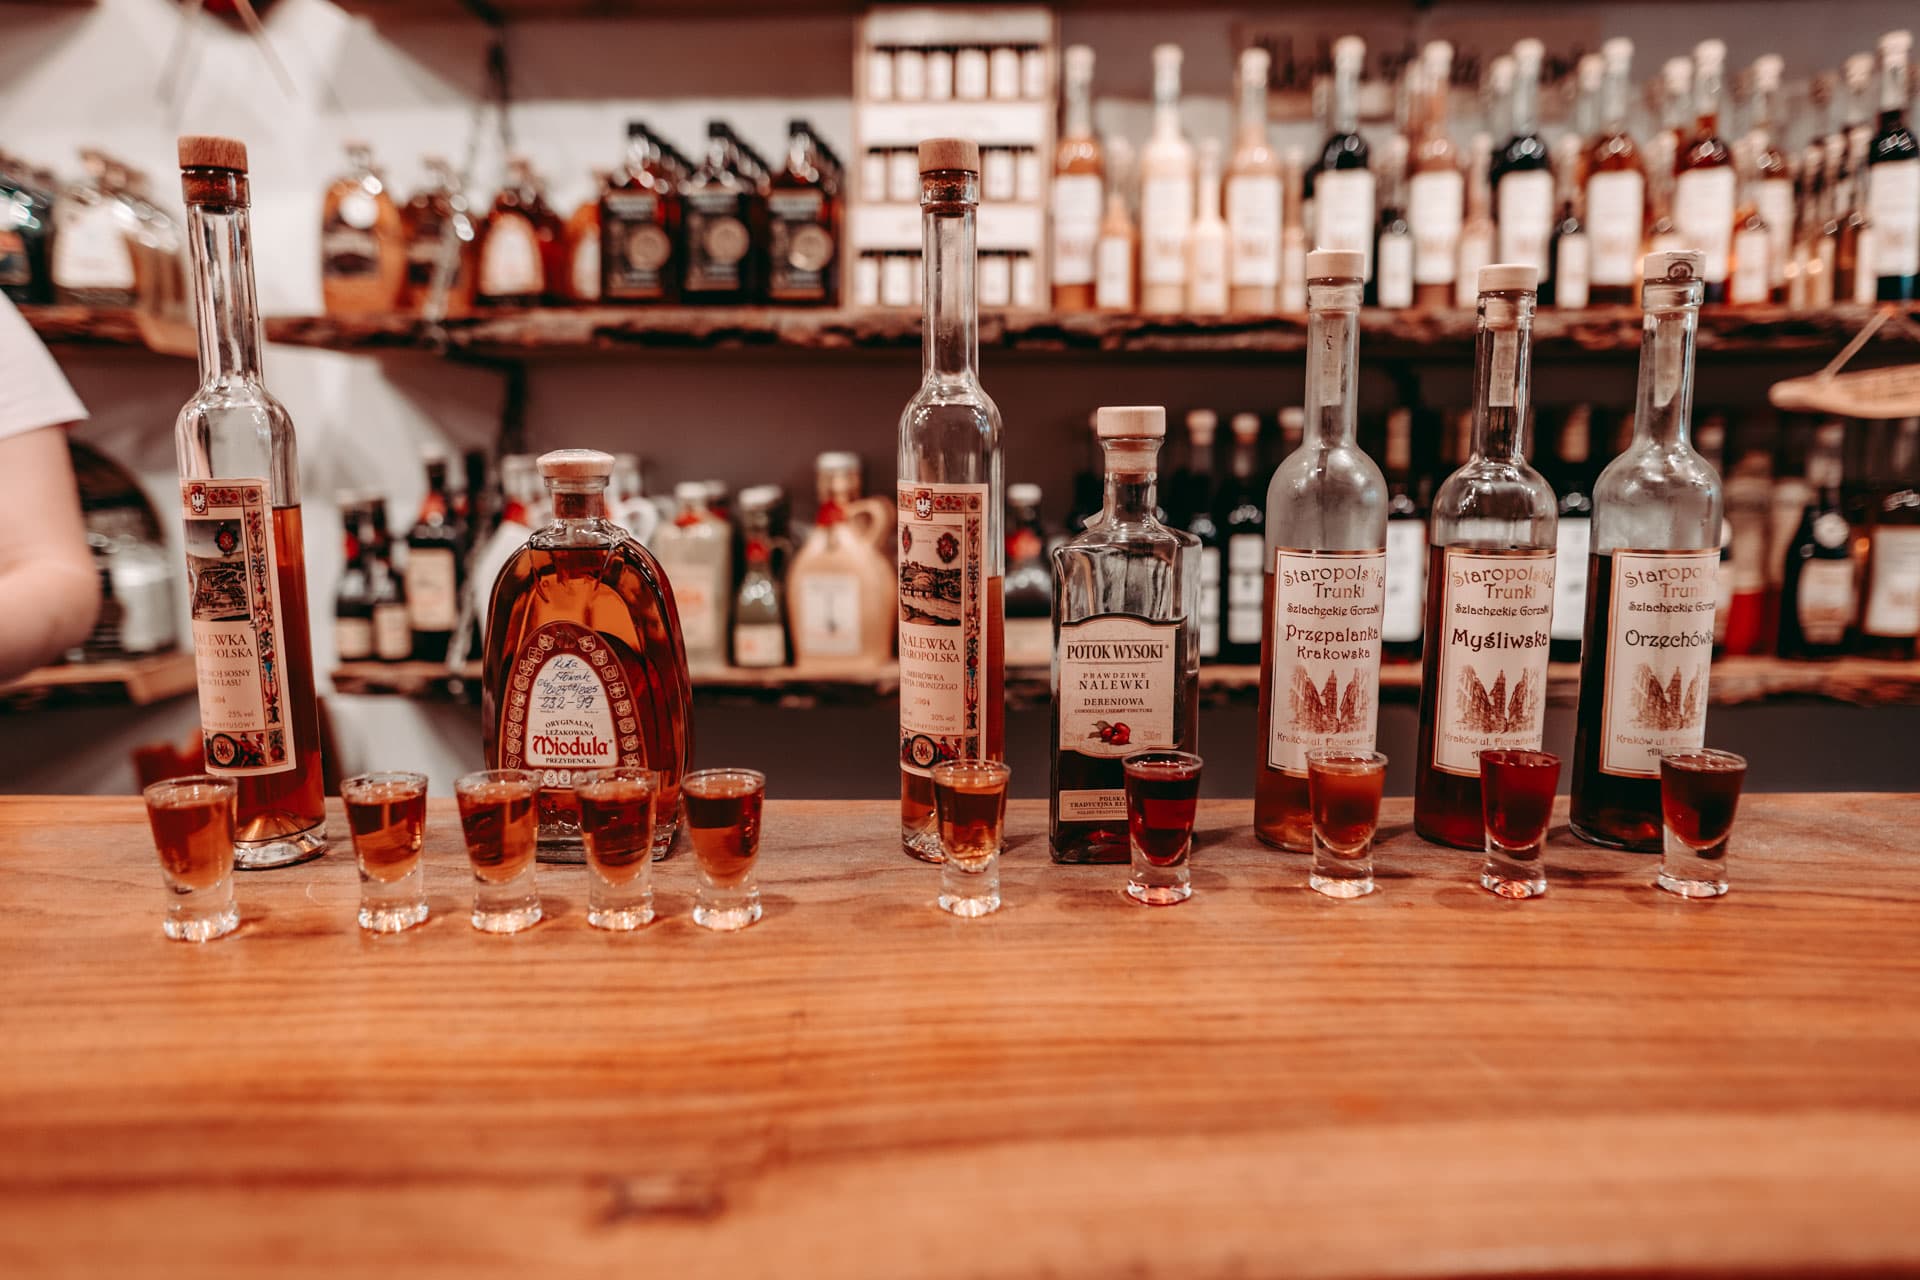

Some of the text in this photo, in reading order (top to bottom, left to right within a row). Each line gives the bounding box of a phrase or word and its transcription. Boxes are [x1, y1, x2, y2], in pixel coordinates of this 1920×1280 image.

[1624, 566, 1702, 588] Staropo
[1313, 582, 1365, 599] Trunki
[1483, 582, 1537, 600] Trunki
[1659, 582, 1700, 599] Trun
[901, 631, 957, 651] NALEWKA
[1286, 624, 1379, 646] Przepalanka
[1451, 628, 1548, 653] Myśliwska
[1067, 643, 1163, 660] POTOK WYSOKI
[1297, 645, 1371, 660] Krakowska
[1079, 679, 1151, 690] NALEWKI
[1084, 697, 1145, 706] DERENIOWA
[545, 718, 594, 730] ORYGINALNA
[532, 735, 609, 756] Miodula
[545, 757, 597, 765] PREZYDENCKA
